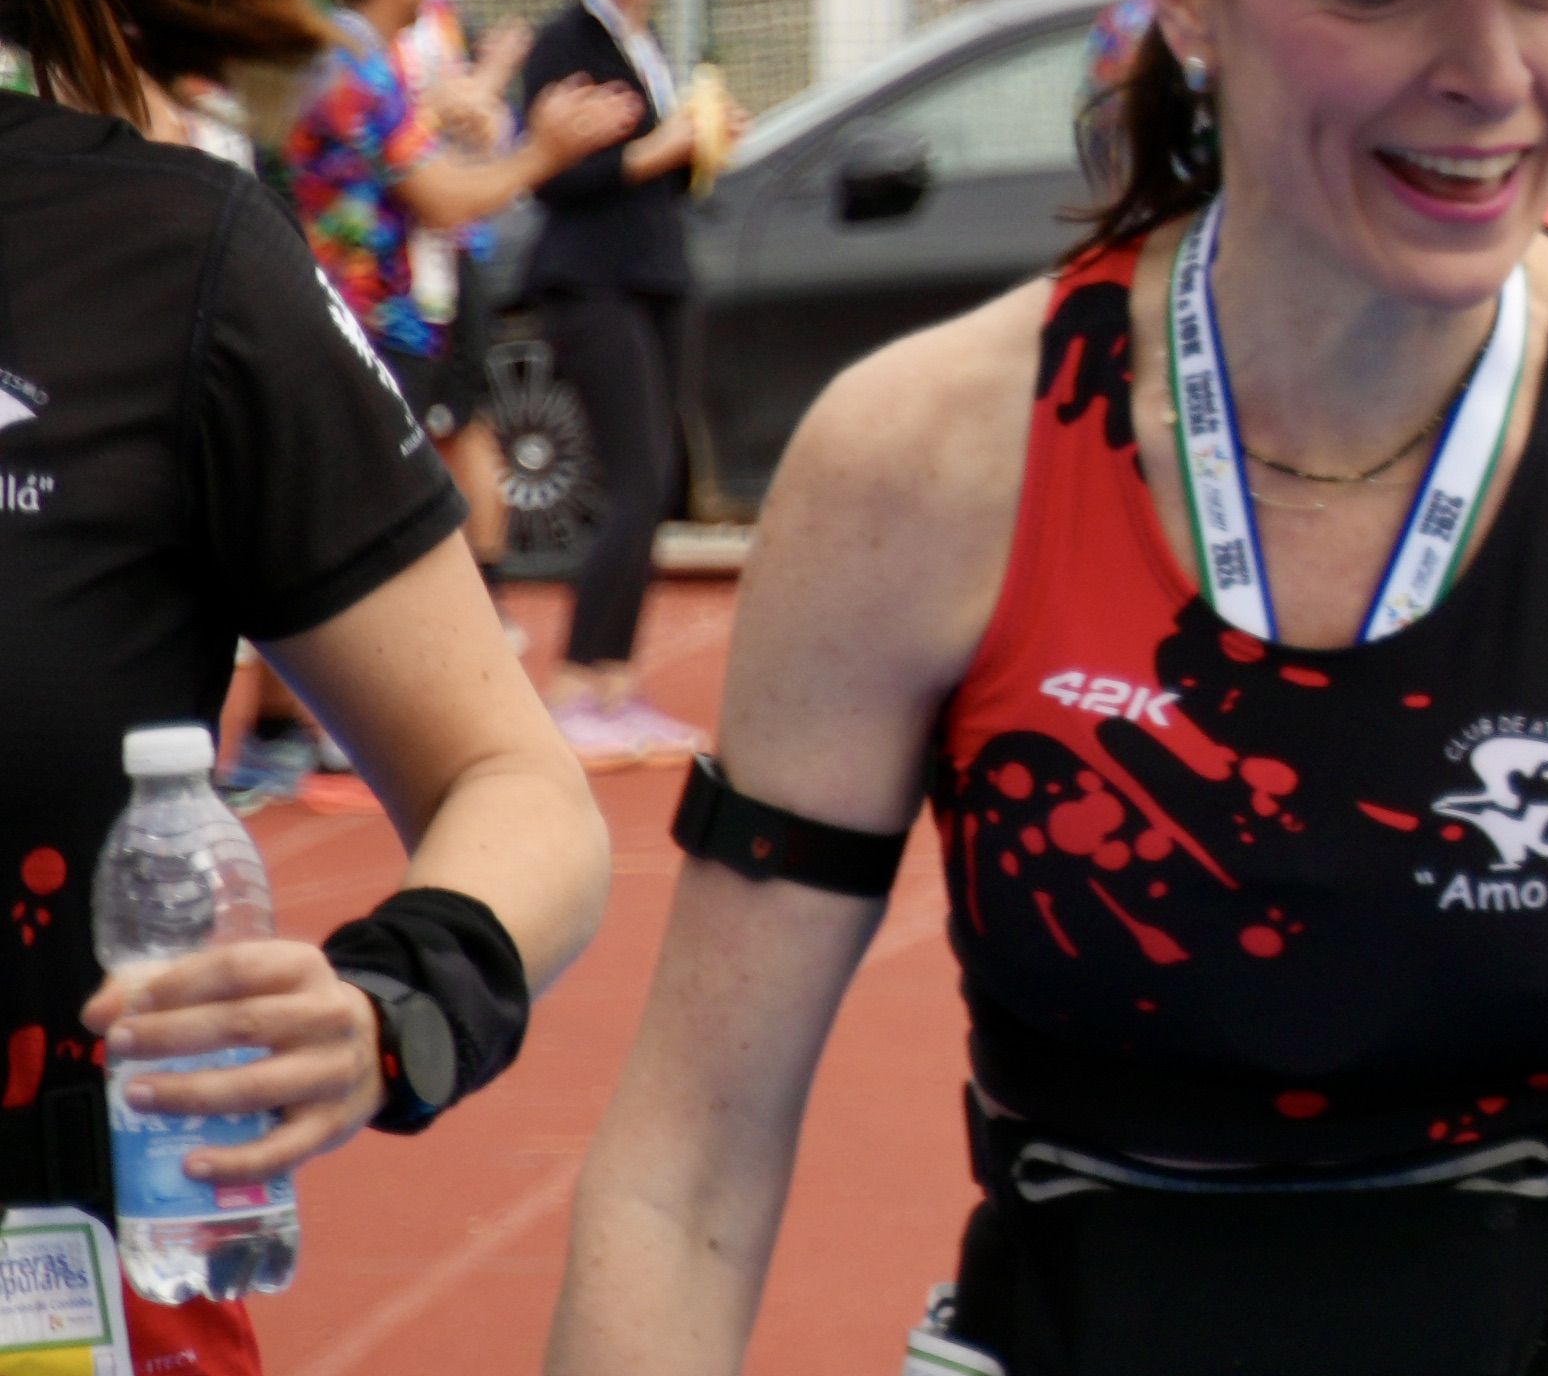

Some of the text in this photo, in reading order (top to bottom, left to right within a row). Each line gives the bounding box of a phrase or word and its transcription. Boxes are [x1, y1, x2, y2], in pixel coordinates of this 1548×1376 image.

[1040, 669, 1183, 727] 42K
[1443, 716, 1496, 763] CLUB
[1497, 715, 1527, 734] DE
